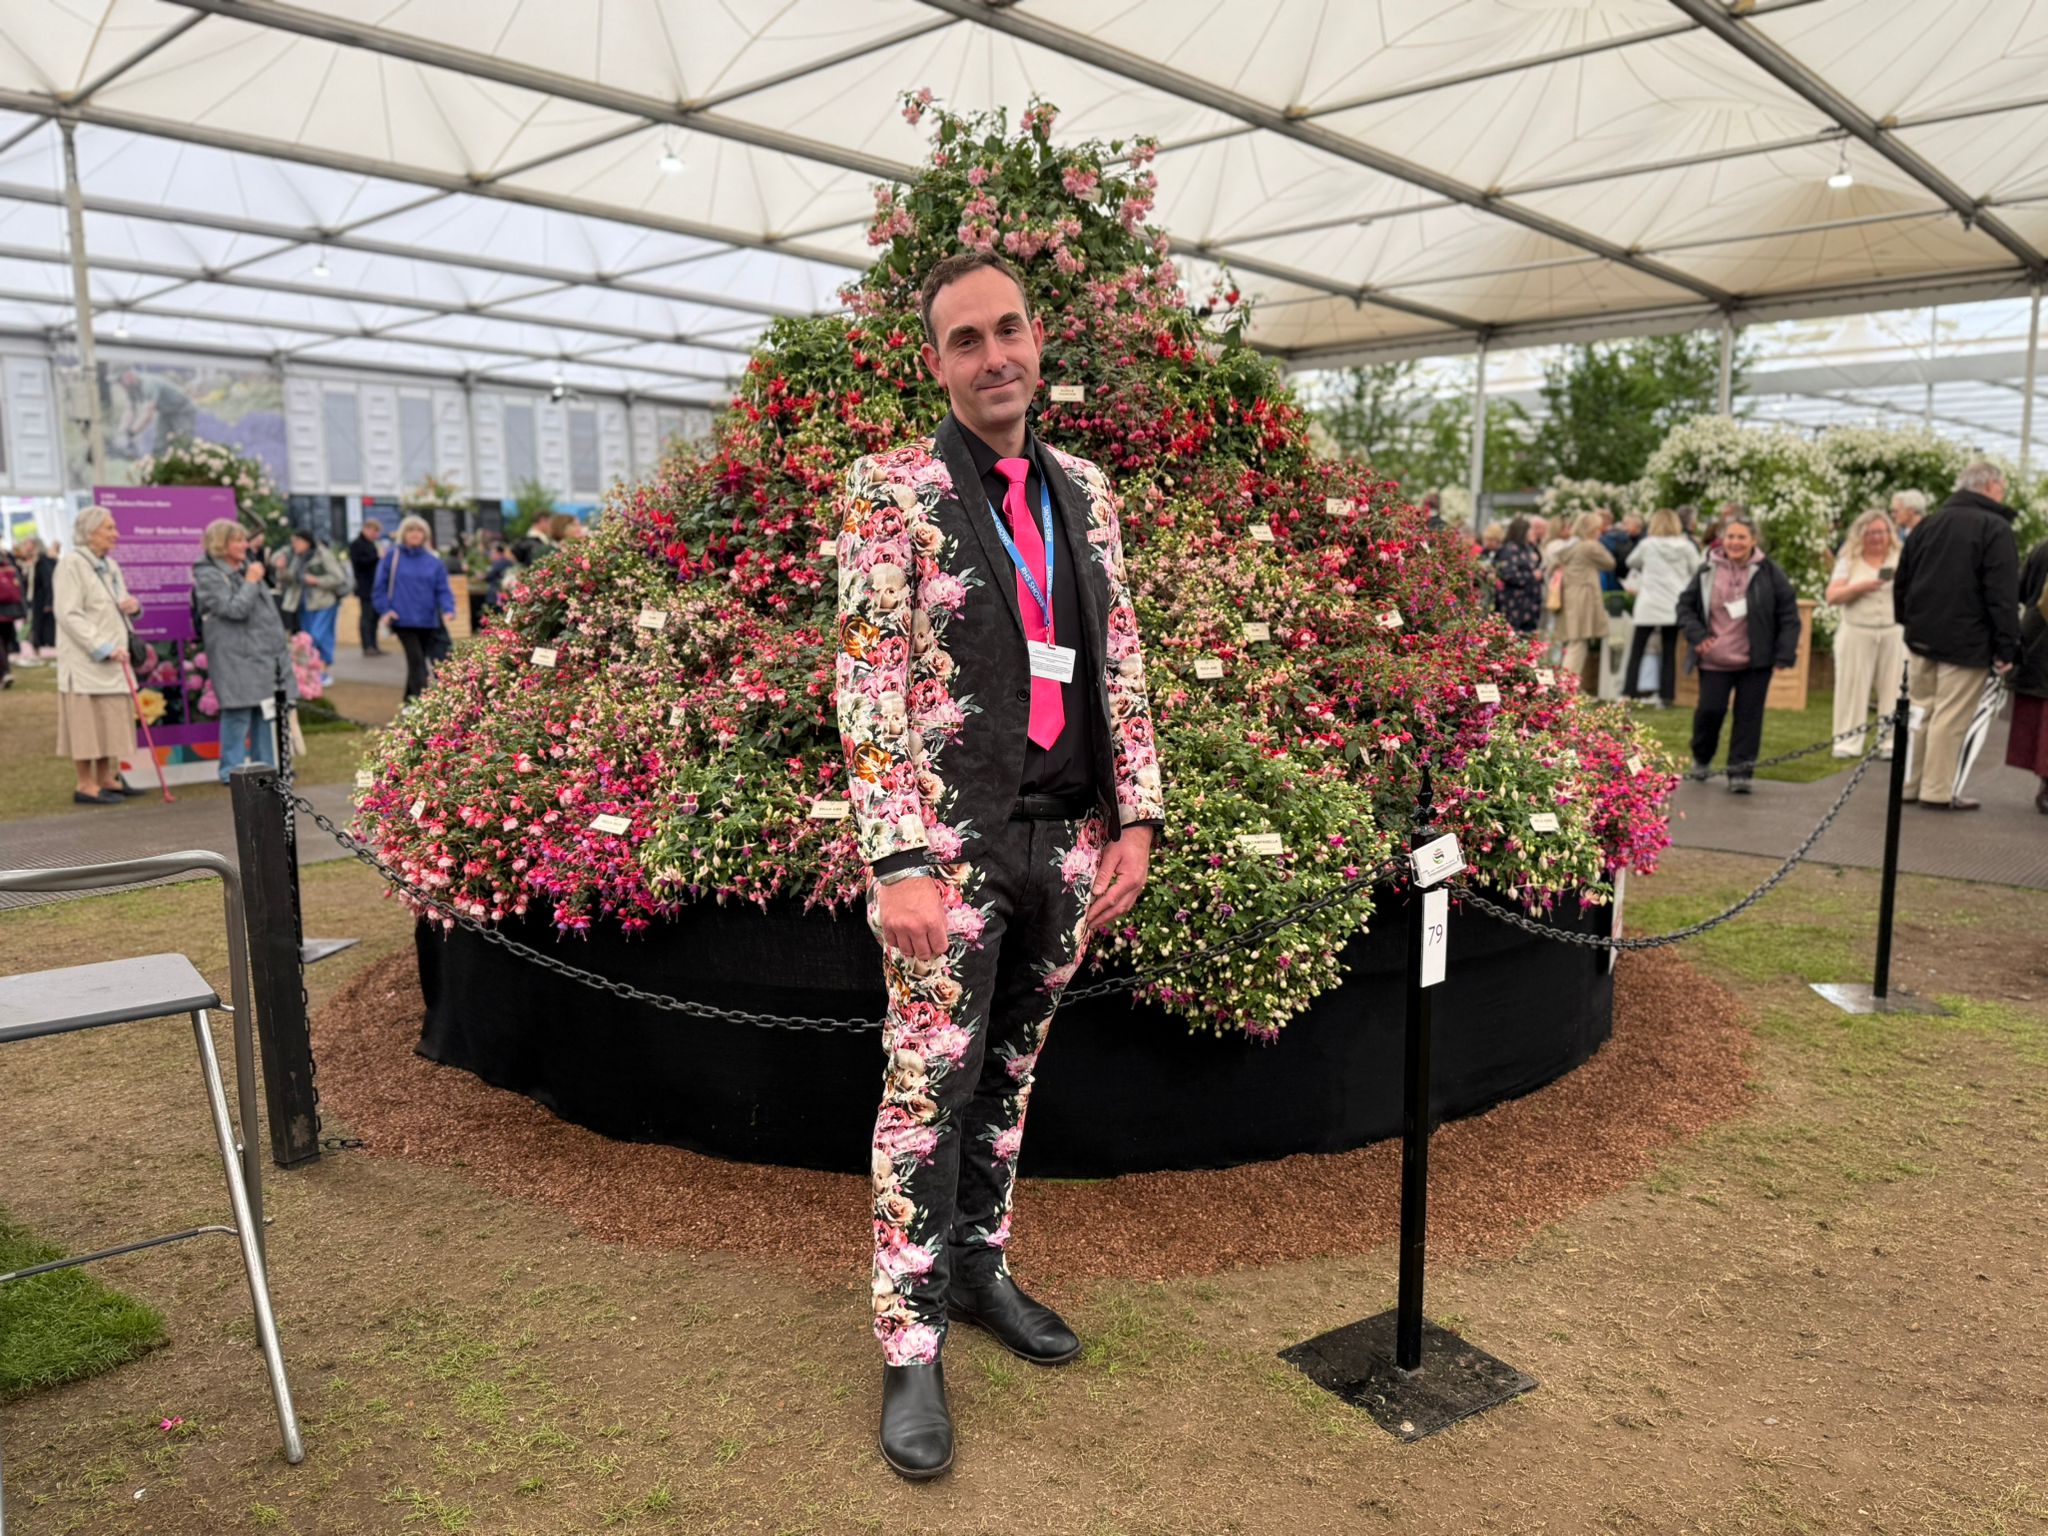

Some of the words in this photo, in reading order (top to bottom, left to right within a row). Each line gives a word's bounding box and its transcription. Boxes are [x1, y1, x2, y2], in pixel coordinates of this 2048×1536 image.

[996, 522, 1011, 546] SHOWS
[1020, 566, 1032, 582] RHS
[1028, 581, 1045, 608] SHOWS
[1428, 923, 1443, 947] 79
